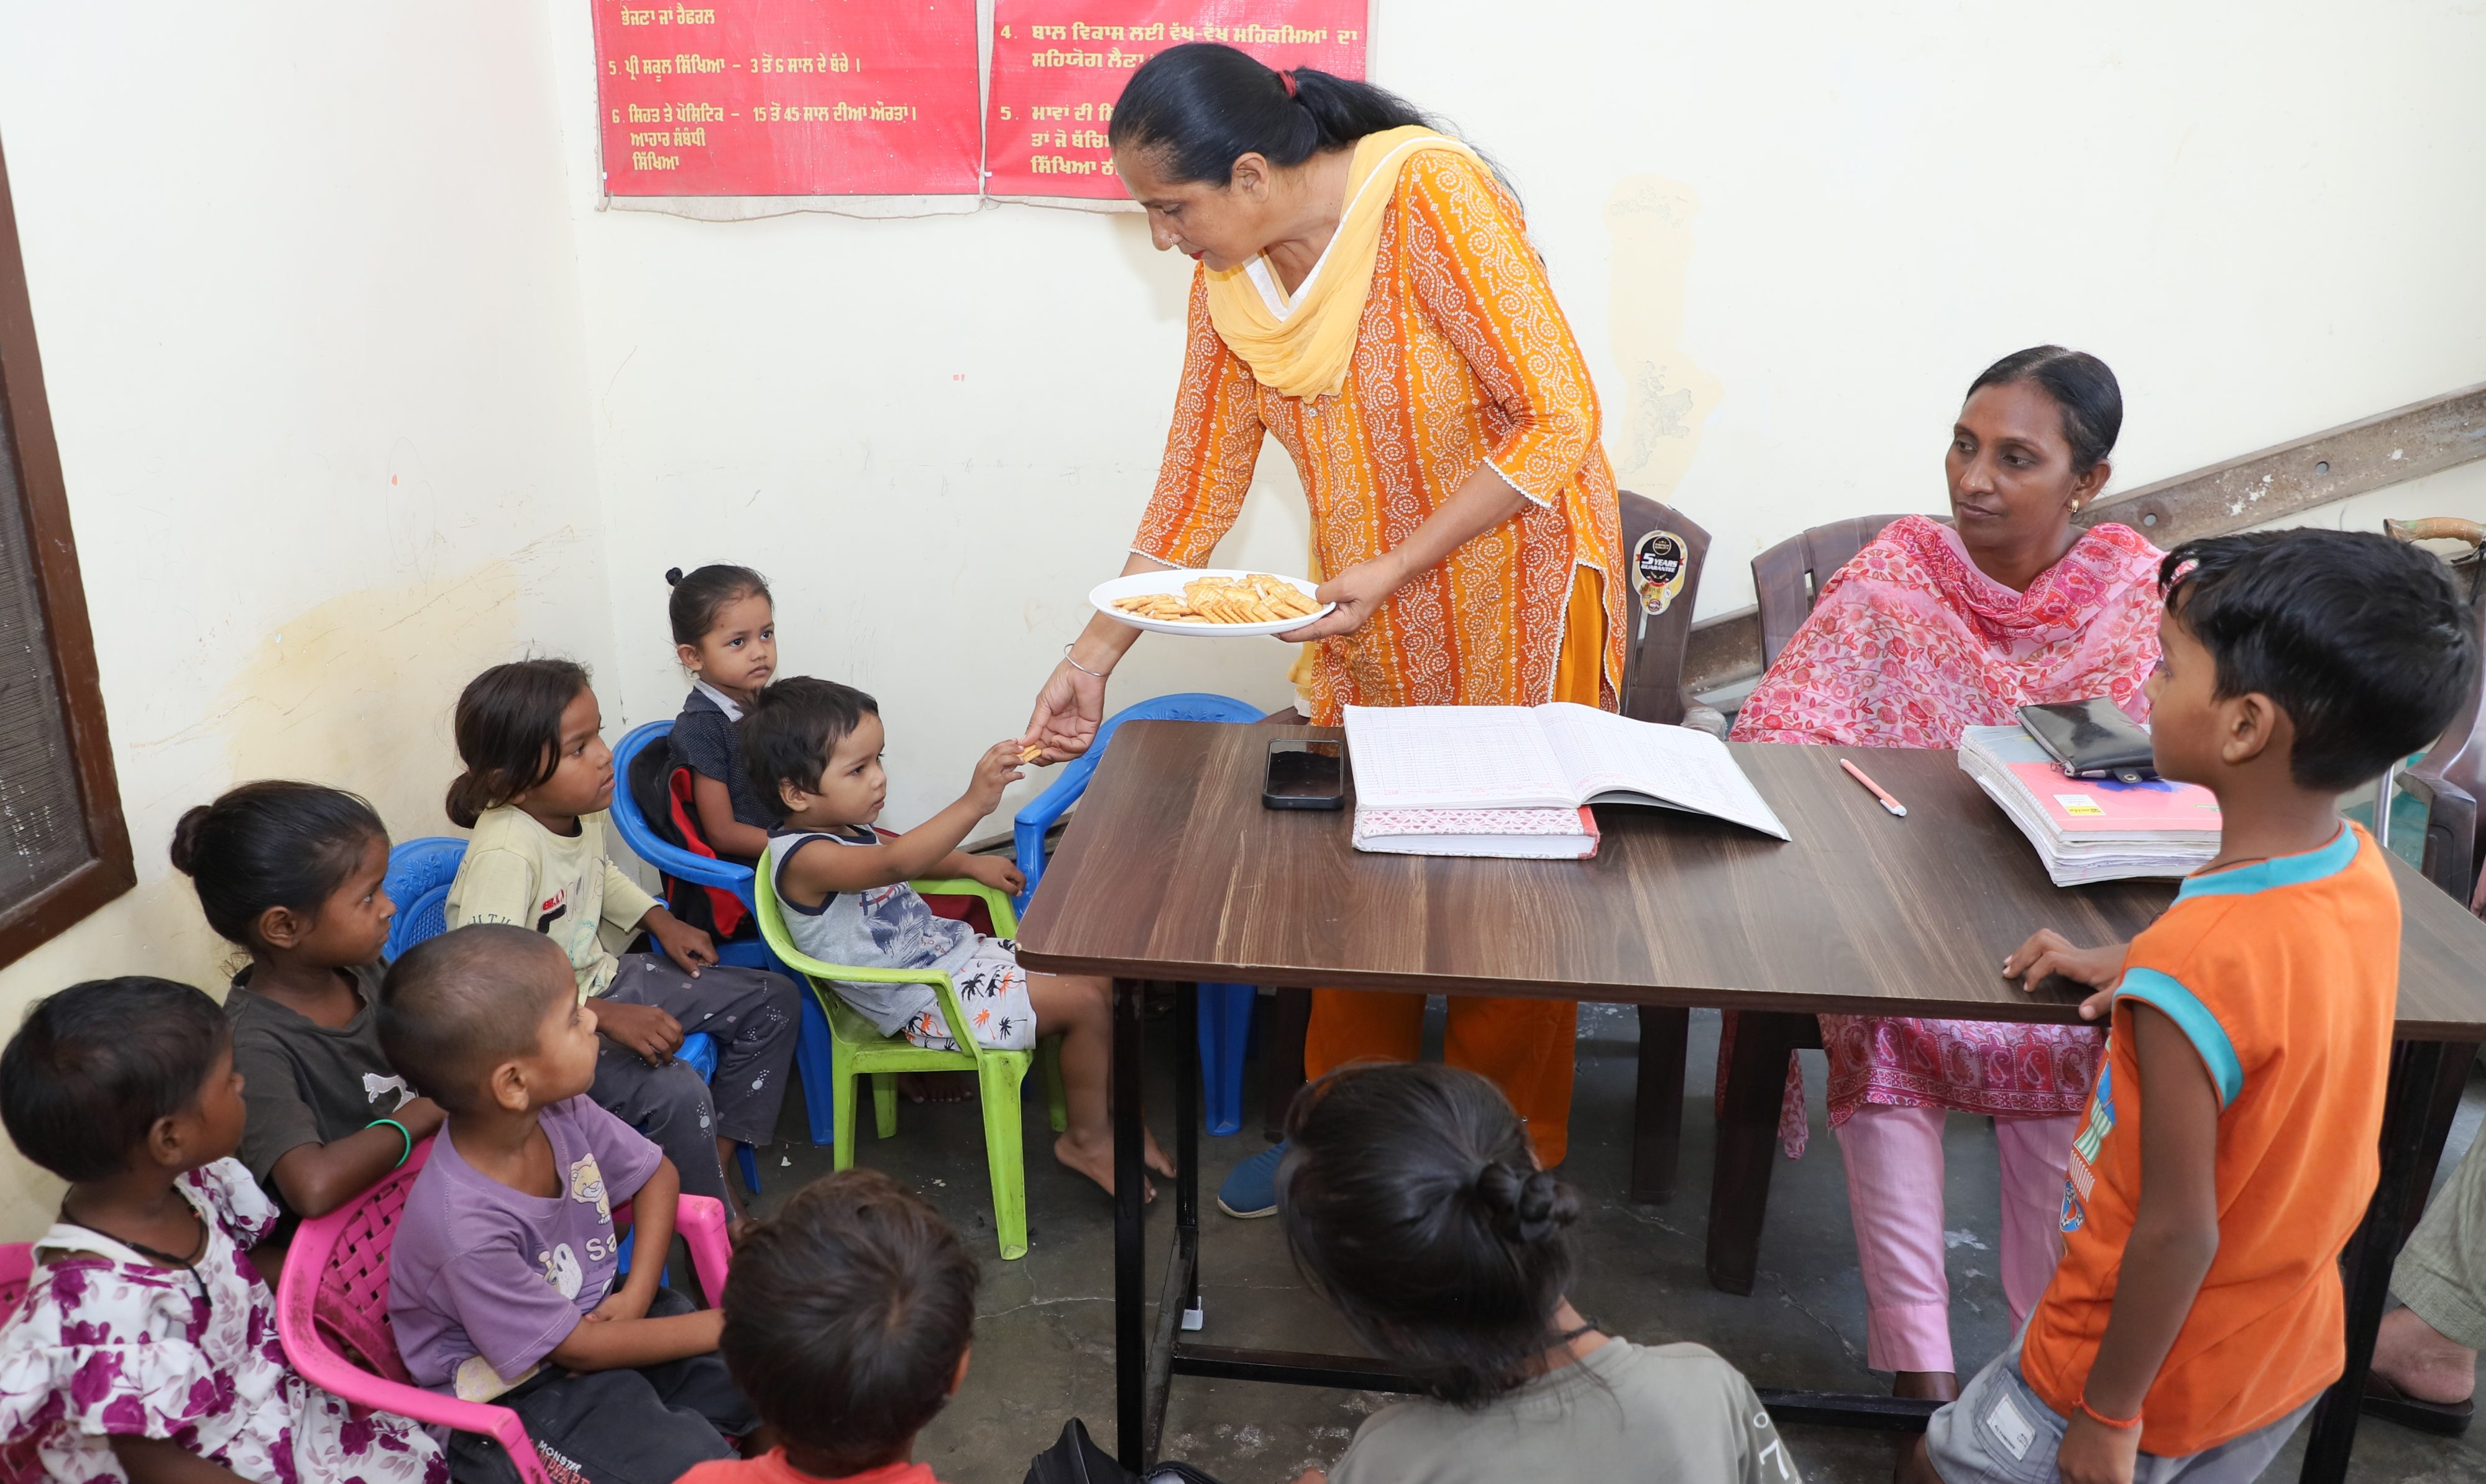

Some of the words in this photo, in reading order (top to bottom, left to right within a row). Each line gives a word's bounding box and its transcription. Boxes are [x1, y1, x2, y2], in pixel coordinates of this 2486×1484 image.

[658, 9, 674, 25] ਜਾਂ
[676, 2, 715, 25] ਰੈਫਰਲ
[1032, 25, 1066, 40] ਬਾਲ
[1071, 21, 1124, 40] ਵਿਕਾਸ
[1129, 22, 1165, 40] ਲਈ
[1337, 29, 1358, 45] ਦਾ
[641, 59, 672, 82] ਸਕੂਲ
[674, 53, 725, 73] ਸਿੱਖਿਆ
[750, 58, 759, 73] 3
[761, 53, 773, 73] ਤੋਂ
[775, 58, 784, 73] 6
[786, 57, 814, 73] ਸਾਲ
[816, 52, 827, 73] ਦੇ
[830, 52, 849, 73] ਬੱਚੇ
[1108, 47, 1144, 68] ਲੈਣਾ
[663, 103, 673, 122] ਤੇ
[753, 107, 767, 122] 15
[769, 101, 781, 122] ਤੋਂ
[783, 106, 799, 121] 45
[802, 106, 830, 121] ਸਾਲ
[832, 101, 868, 121] ਦੀਆਂ
[1031, 104, 1070, 121] ਮਾਵਾਂ
[1073, 103, 1093, 121] ਦੀ
[630, 132, 670, 147] ਆਹਾਰ
[1031, 130, 1050, 148] ਤਾਂ
[1054, 129, 1067, 148] ਜੋ
[631, 151, 679, 170] ਸਿੱਖਿਆ
[1030, 155, 1097, 175] ਸਿੱਖਿਆ
[1641, 552, 1656, 565] 5
[1654, 558, 1678, 568] YEARS
[1641, 564, 1676, 573] GUARANTEE
[538, 1440, 582, 1473] MONSTER
